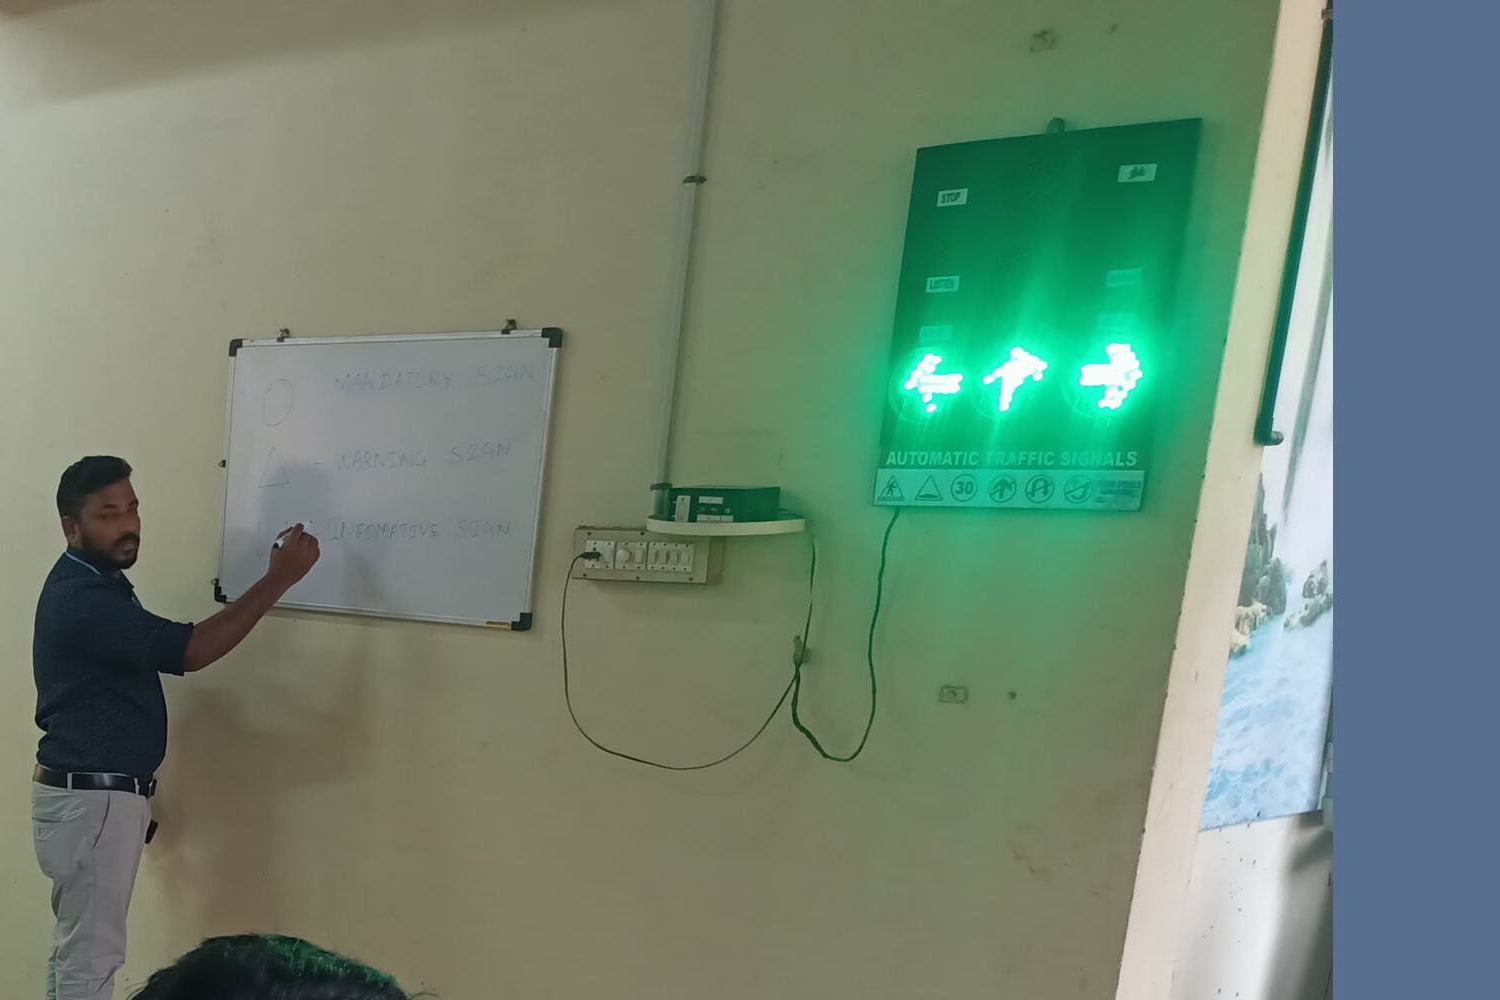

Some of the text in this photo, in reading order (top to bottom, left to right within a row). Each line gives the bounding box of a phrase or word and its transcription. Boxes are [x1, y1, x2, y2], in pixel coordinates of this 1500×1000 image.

[940, 191, 962, 204] STOP
[929, 278, 955, 290] LISTEN
[475, 364, 534, 386] SIGN
[337, 442, 512, 472] WARNING SIGN
[885, 449, 1140, 467] AUTOMATIC TRAFFIC SIGNALS
[955, 480, 974, 495] 30
[456, 520, 513, 539] SIGN
